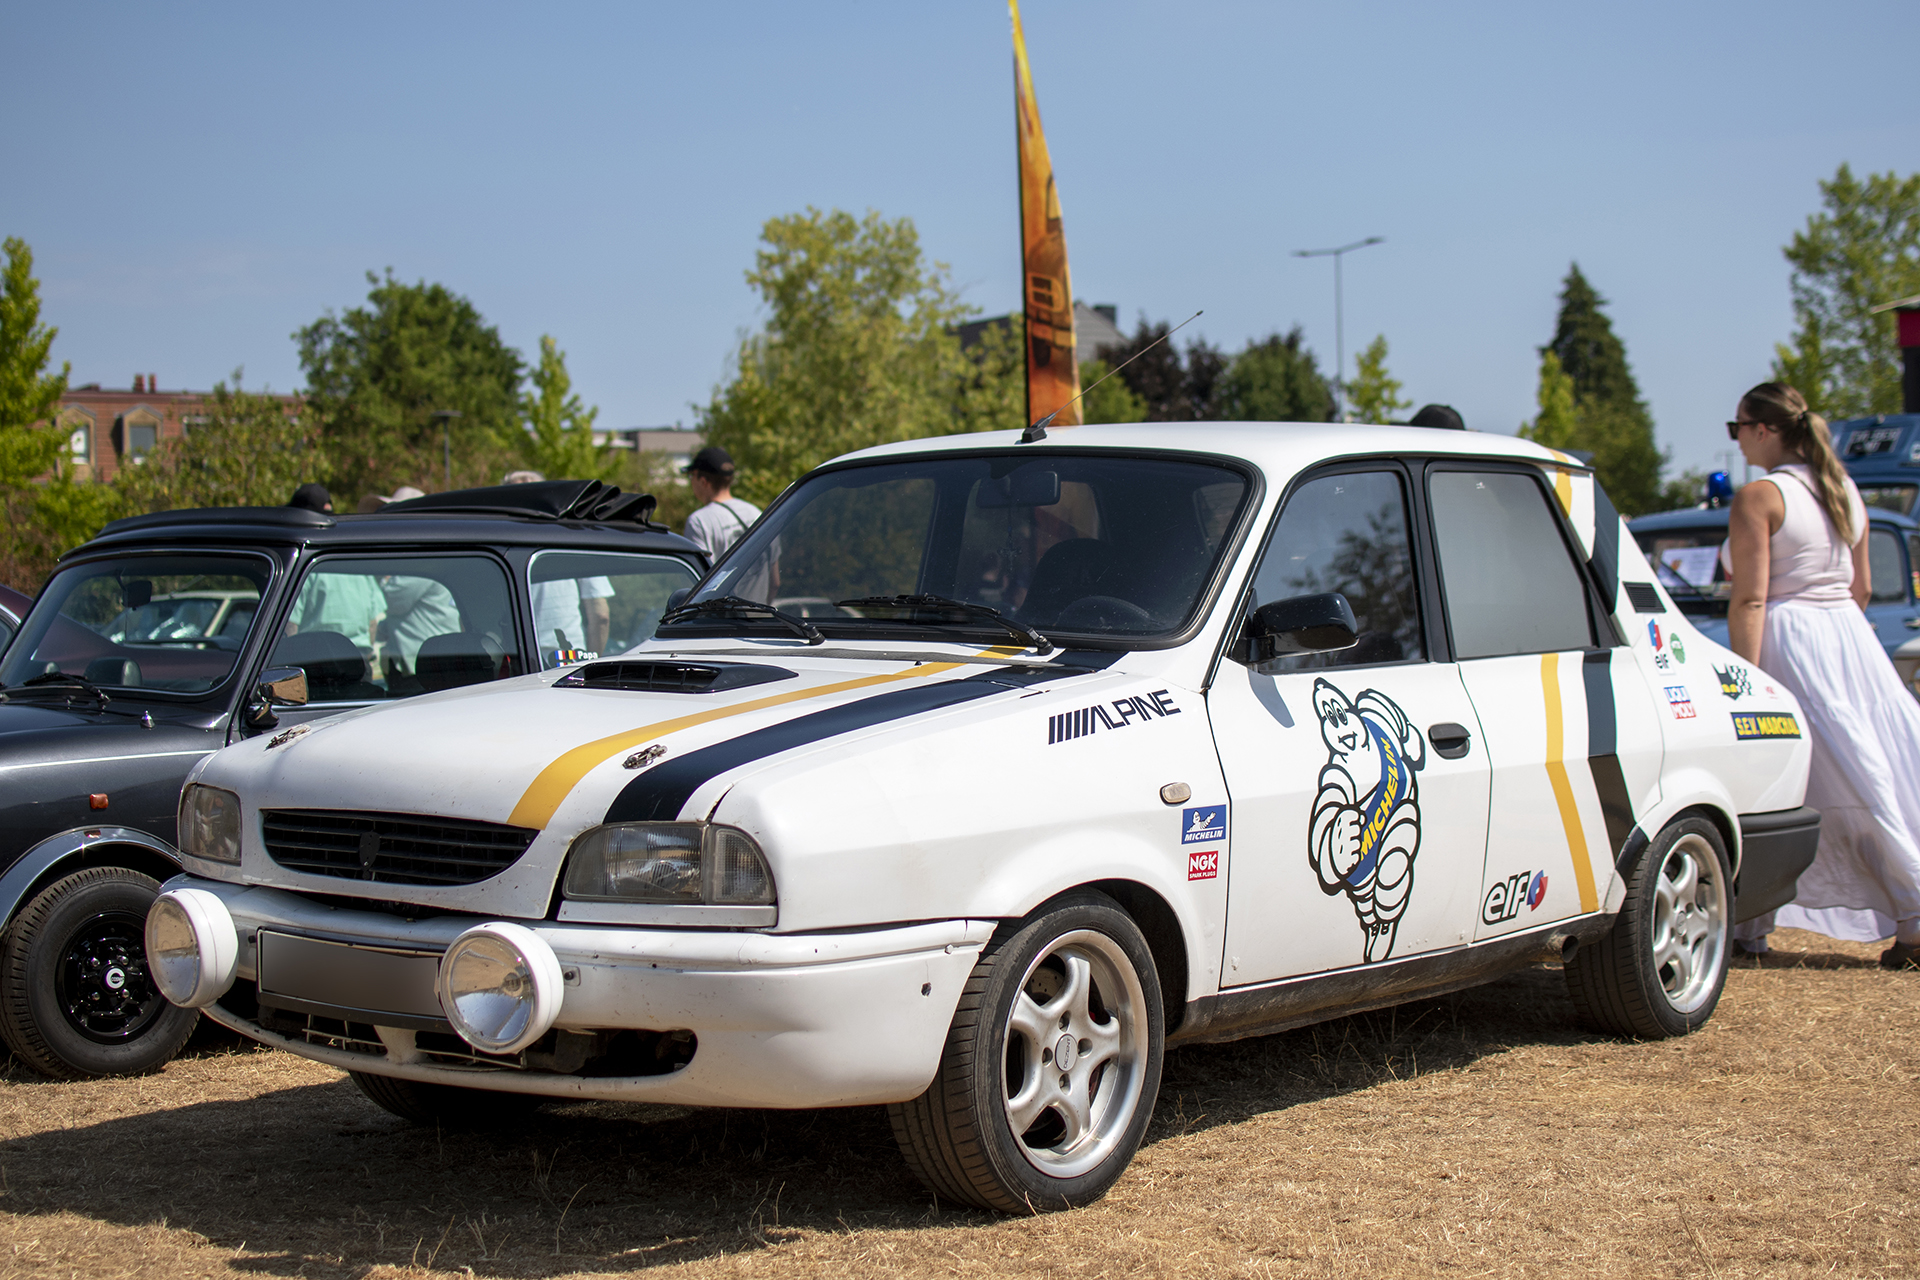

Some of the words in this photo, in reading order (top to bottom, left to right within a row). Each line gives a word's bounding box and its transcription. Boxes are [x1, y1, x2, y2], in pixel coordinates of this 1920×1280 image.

[578, 650, 598, 660] Papa
[1655, 654, 1670, 669] elf
[1670, 703, 1697, 719] MOLY
[1756, 716, 1800, 736] MARCHAL
[1360, 737, 1398, 861] MICHELIN
[1184, 830, 1223, 842] MICHELIN
[1189, 853, 1217, 872] NGK
[1482, 869, 1531, 926] elf
